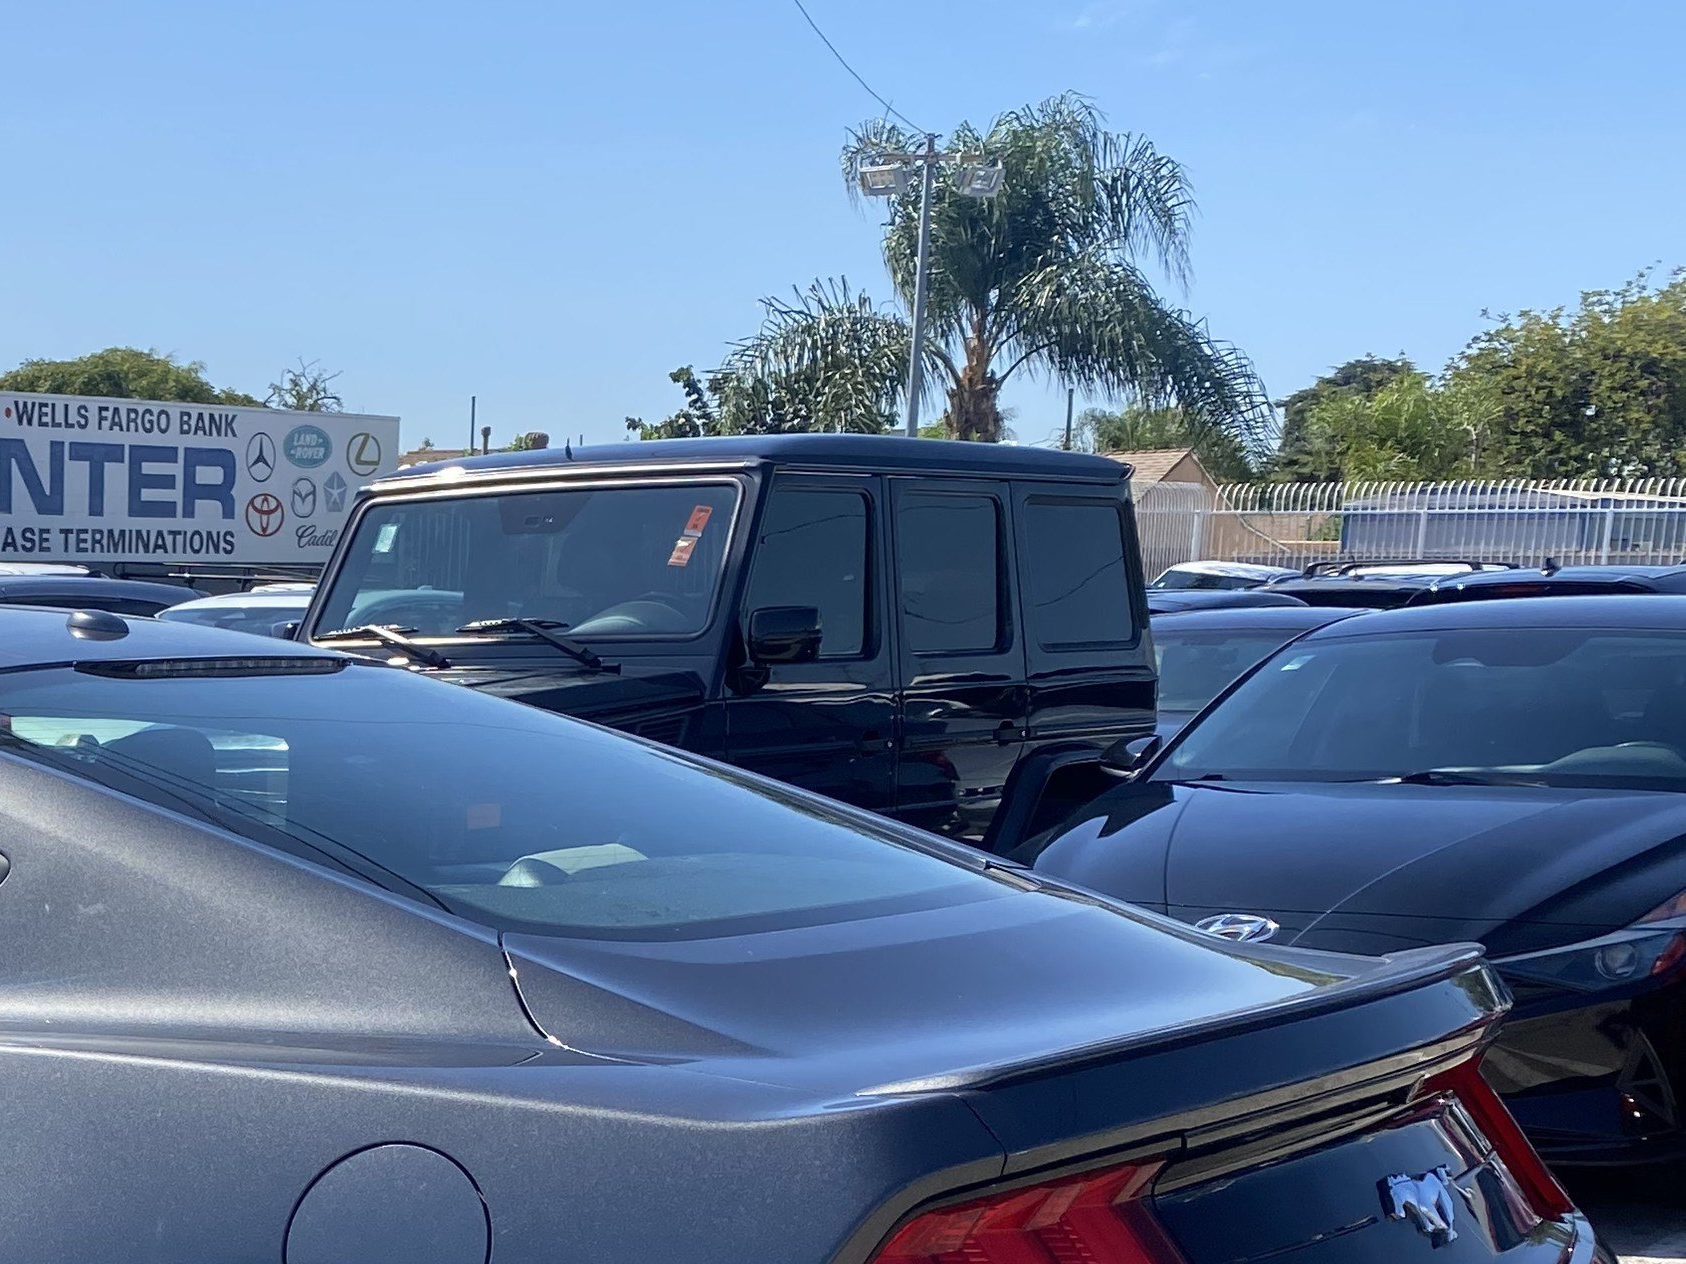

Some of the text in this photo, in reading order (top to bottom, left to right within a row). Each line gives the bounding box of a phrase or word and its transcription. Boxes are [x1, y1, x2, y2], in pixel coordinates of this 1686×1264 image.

[14, 400, 90, 430] WELLS
[97, 406, 171, 434] FARGO
[179, 411, 238, 438] BANK
[293, 433, 317, 446] LAND
[295, 446, 325, 459] ROVER
[59, 528, 235, 555] TERMINATIONS
[295, 524, 338, 549] Cadil
